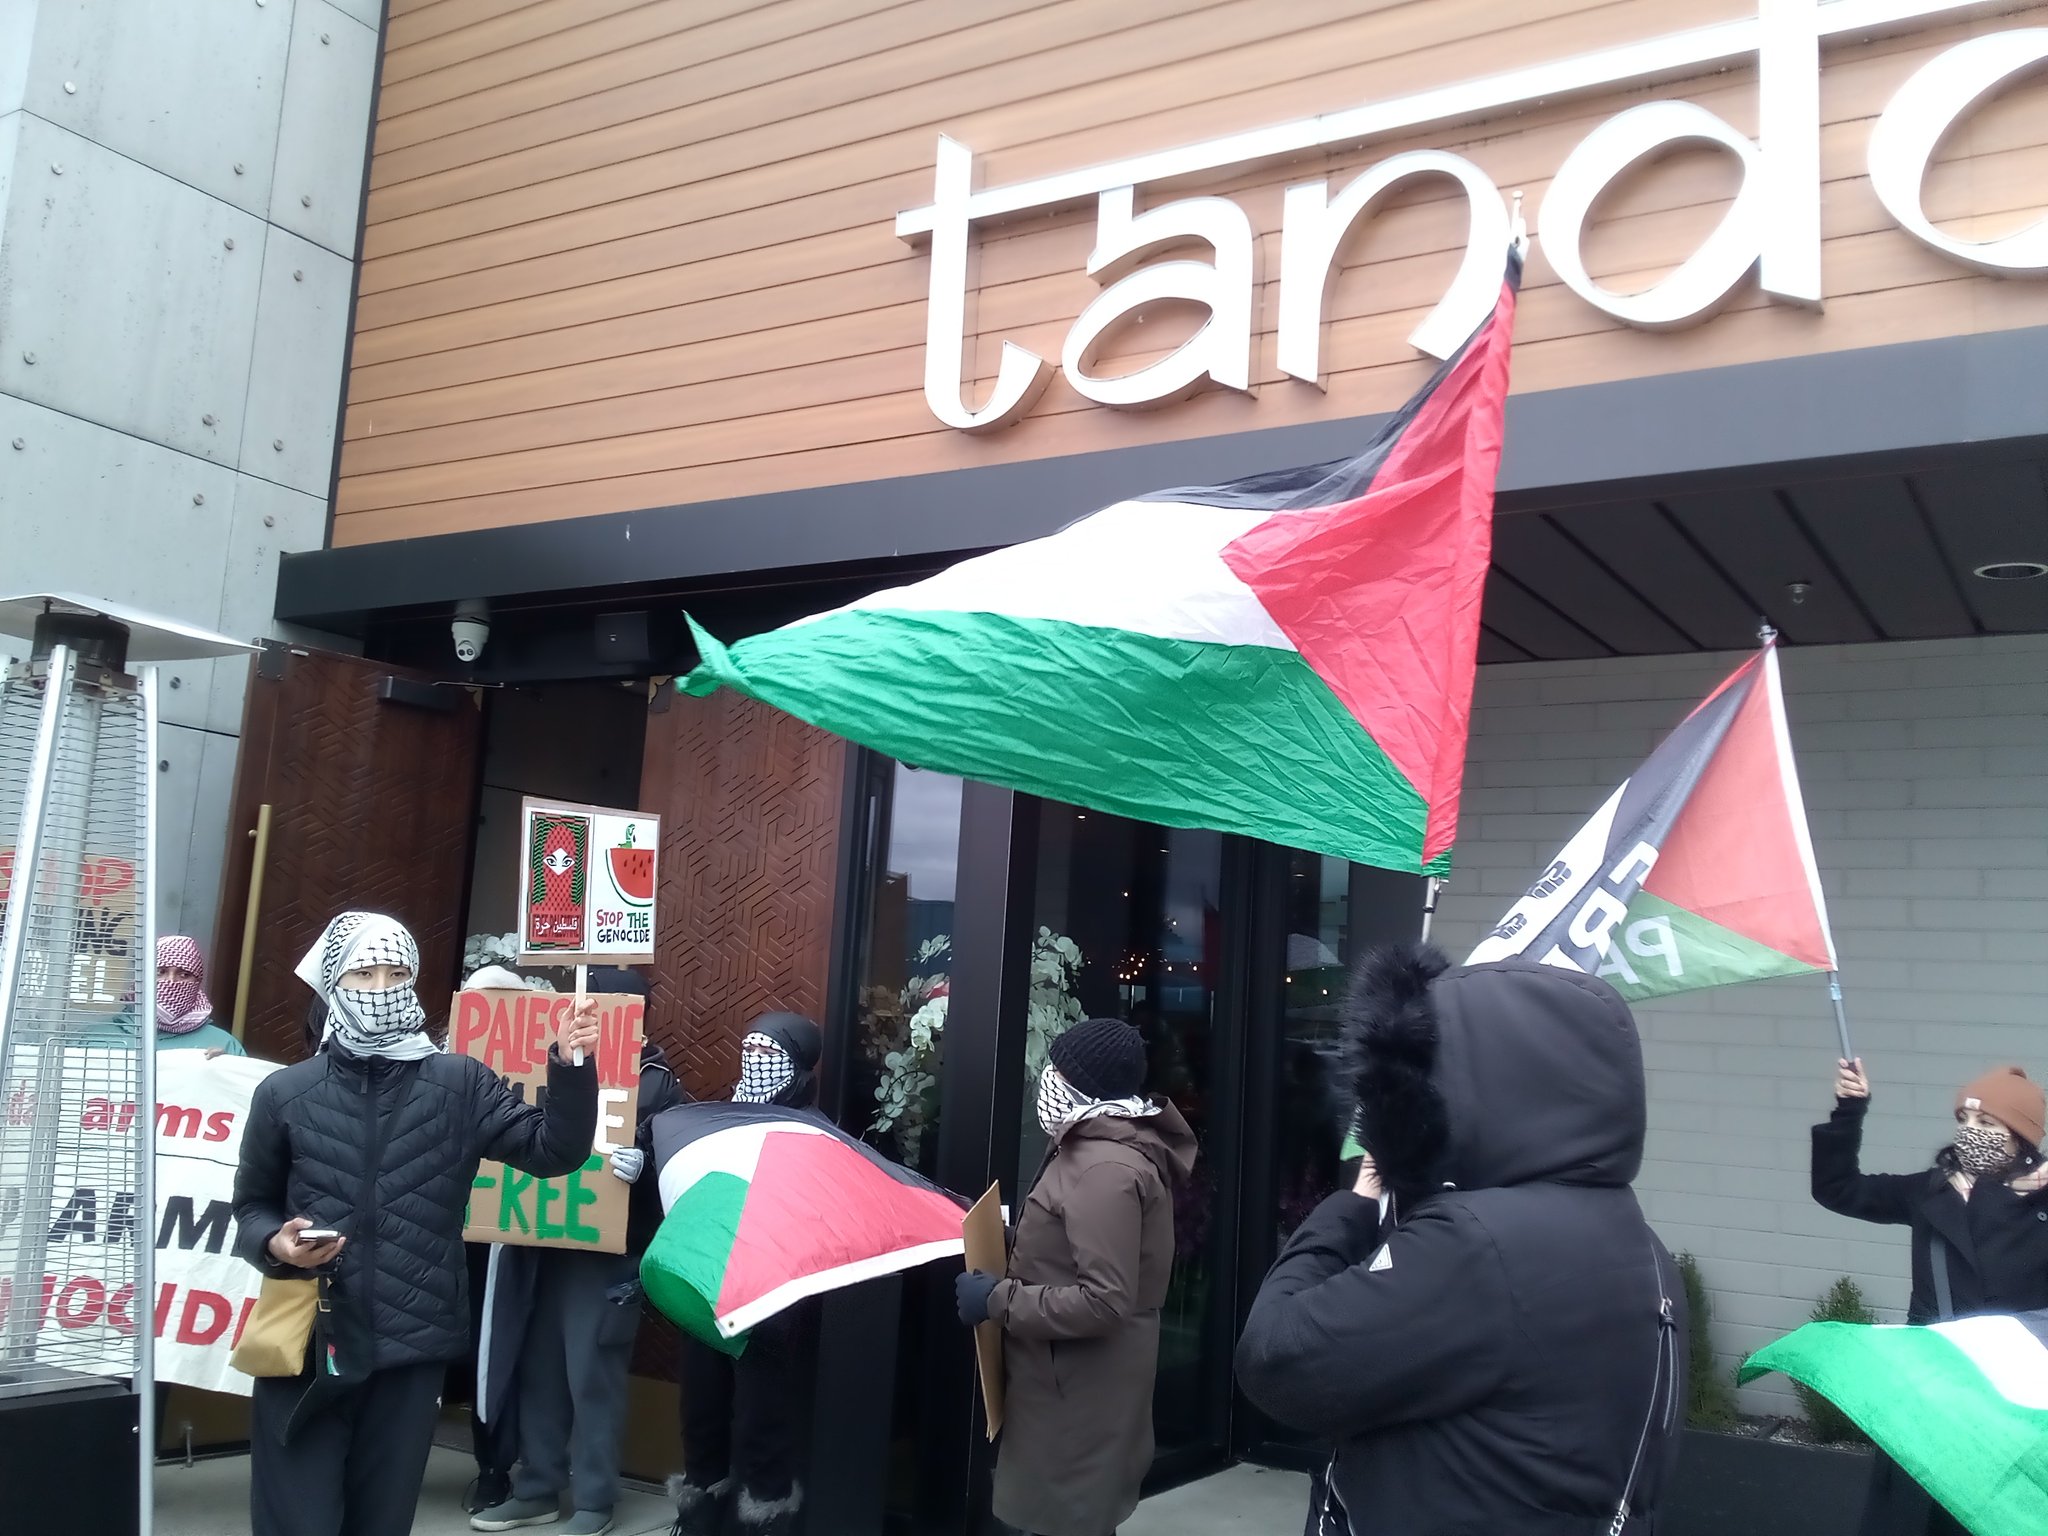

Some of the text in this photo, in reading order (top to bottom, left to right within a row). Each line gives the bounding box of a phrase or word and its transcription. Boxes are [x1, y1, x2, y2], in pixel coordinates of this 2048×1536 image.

[596, 909, 624, 928] STOP
[626, 912, 649, 929] THE
[597, 928, 650, 943] GENOCIDE
